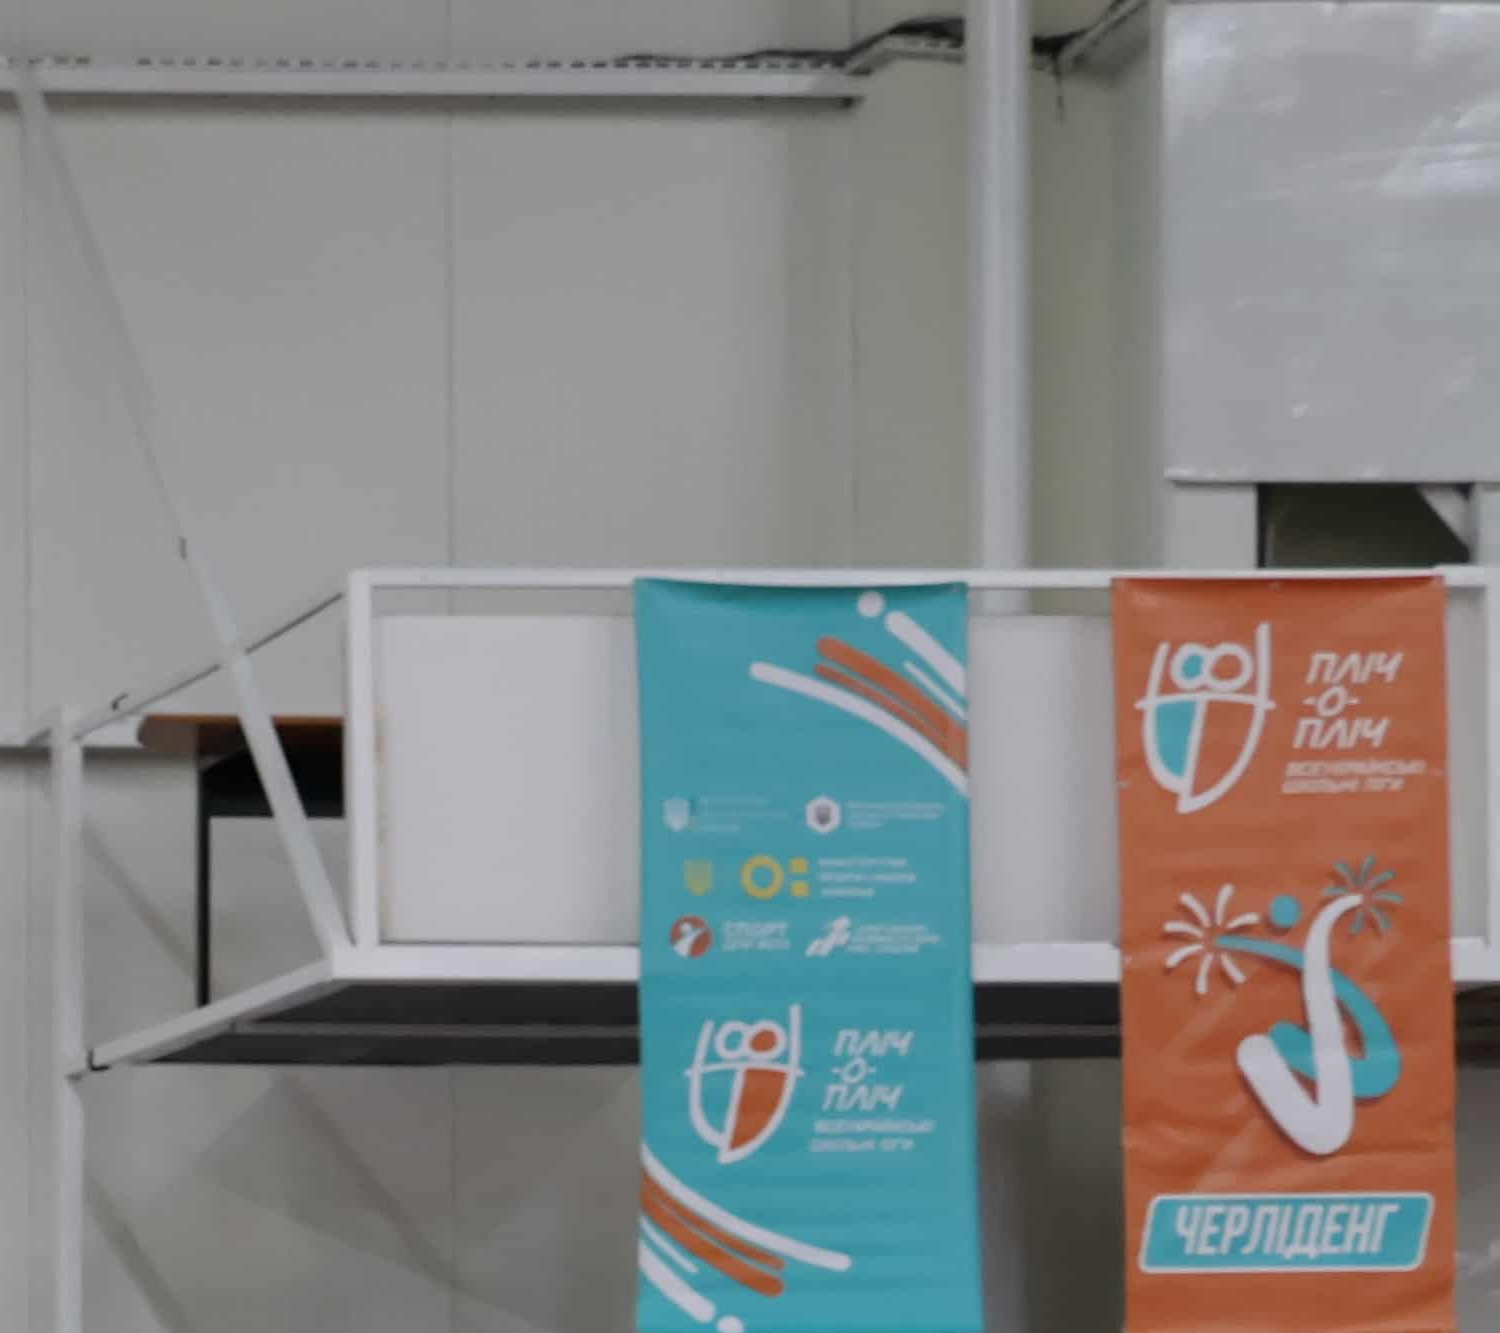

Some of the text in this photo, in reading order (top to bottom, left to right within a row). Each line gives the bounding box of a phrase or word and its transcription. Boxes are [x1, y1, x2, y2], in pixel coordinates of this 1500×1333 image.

[1306, 651, 1404, 684] ПЛІЧ
[1292, 717, 1390, 749] ПЛІЧ
[833, 1029, 914, 1056] ПЛІЧ
[822, 1084, 903, 1111] ПЛІЧ
[1174, 1204, 1400, 1260] ЧЕРЛІДЕНГ
